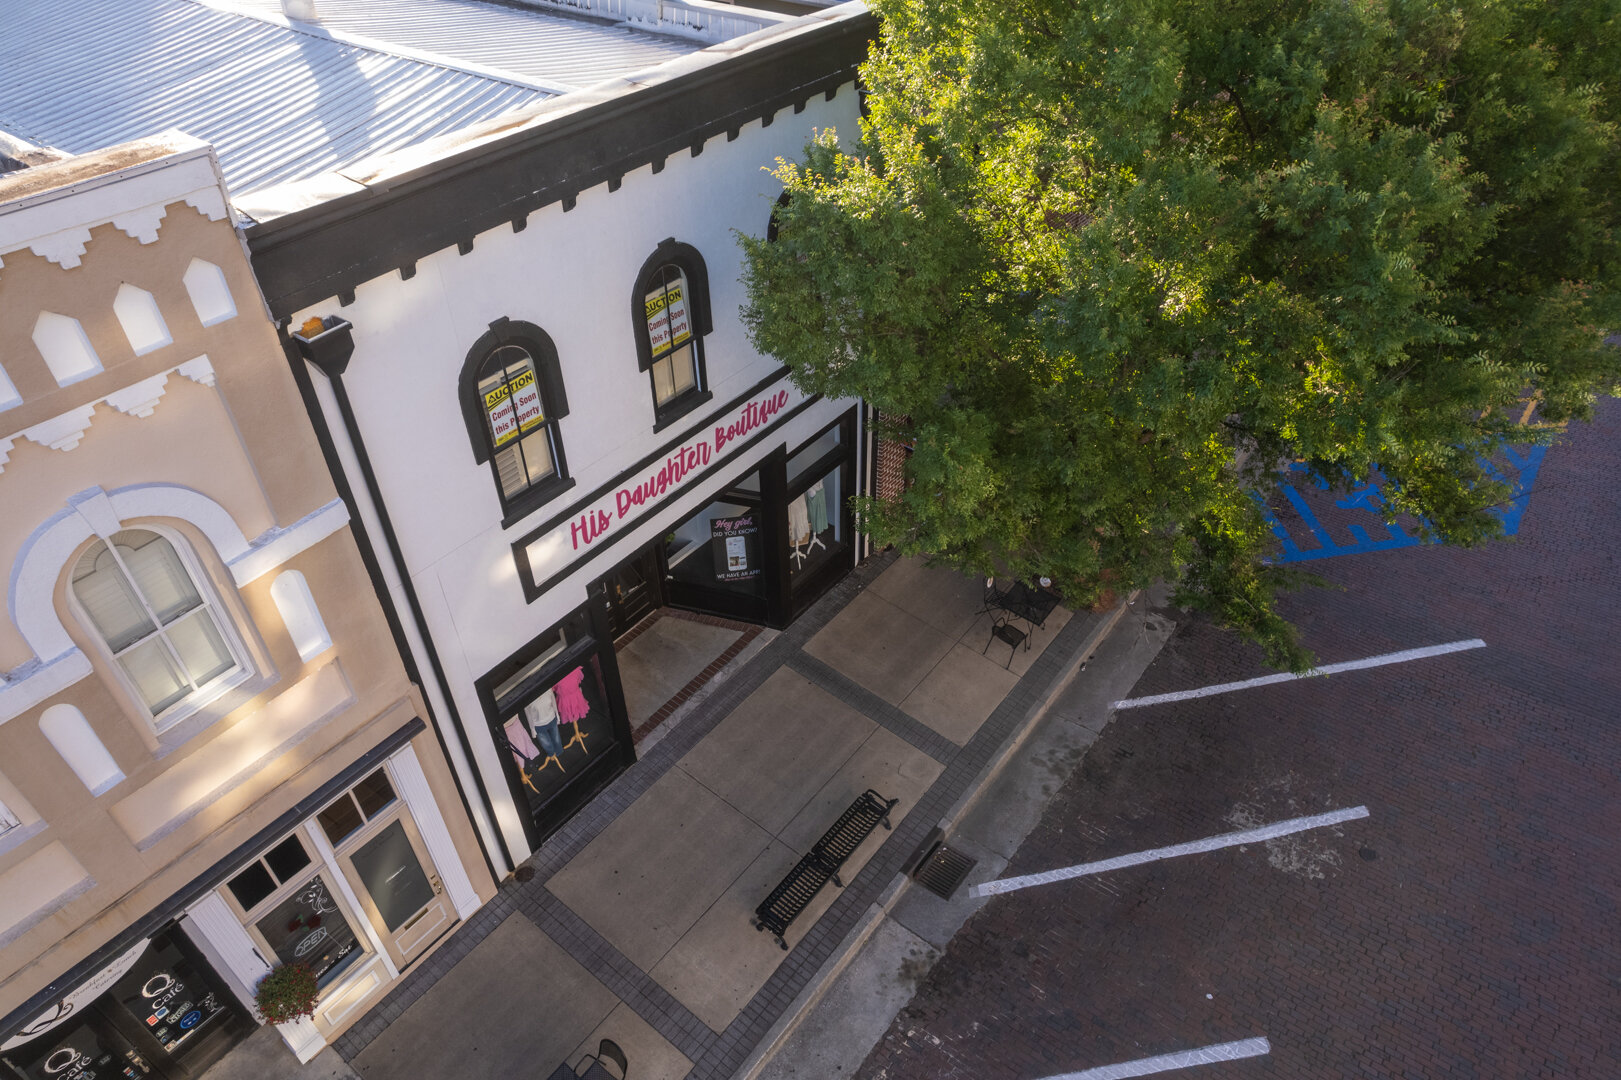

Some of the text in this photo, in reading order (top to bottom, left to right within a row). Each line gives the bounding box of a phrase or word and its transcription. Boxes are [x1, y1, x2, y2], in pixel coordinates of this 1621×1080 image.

[645, 290, 682, 313] AUCTON
[670, 309, 685, 321] Soon
[651, 334, 664, 345] this
[519, 392, 537, 407] Soon
[495, 422, 510, 435] this
[510, 405, 540, 427] Poperty
[570, 390, 789, 550] His Daughter Boutique
[714, 518, 733, 531] Hey
[738, 527, 758, 535] KNOW?
[294, 930, 328, 957] OPEN
[142, 973, 176, 998] Q
[152, 982, 185, 1010] Café
[44, 1047, 82, 1074] Q
